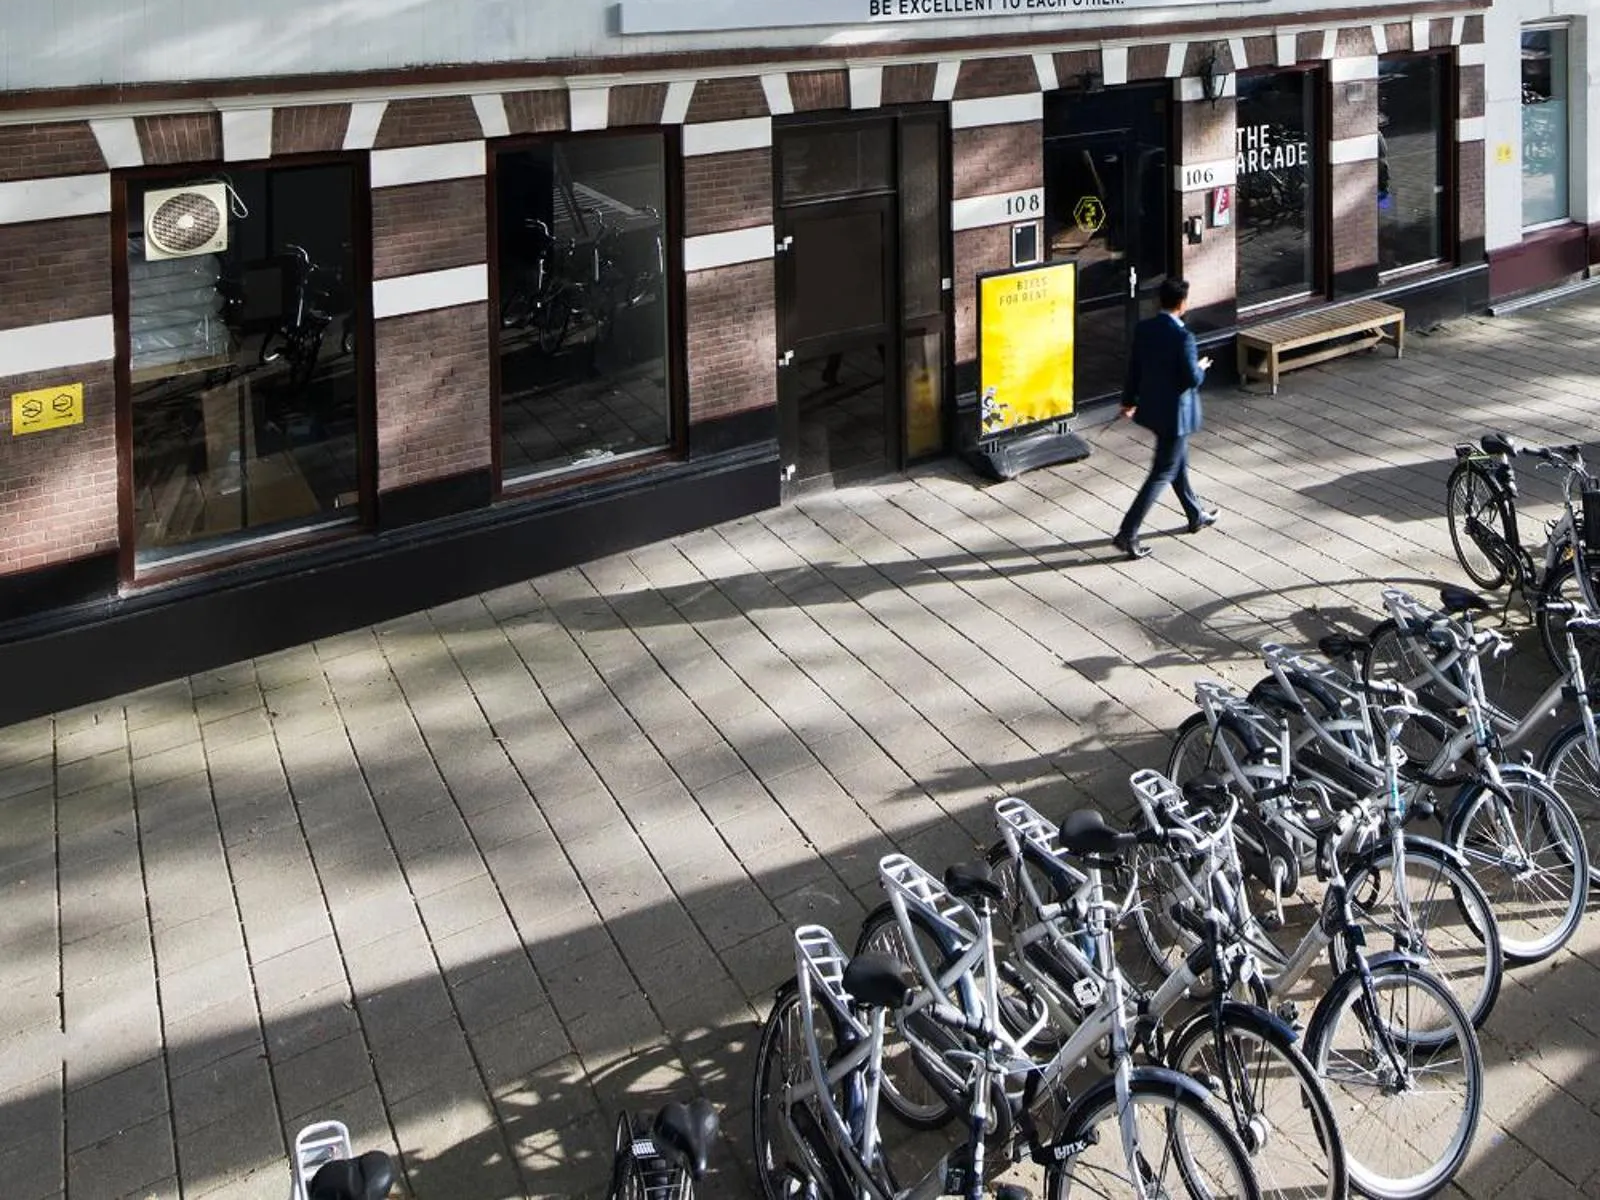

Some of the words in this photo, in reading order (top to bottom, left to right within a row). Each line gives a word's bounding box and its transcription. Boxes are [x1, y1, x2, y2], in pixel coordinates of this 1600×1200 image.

[869, 0, 892, 16] BE
[1236, 124, 1270, 151] THE
[1236, 141, 1308, 175] ARCADE
[1186, 168, 1214, 186] 106
[1006, 194, 1040, 216] 108
